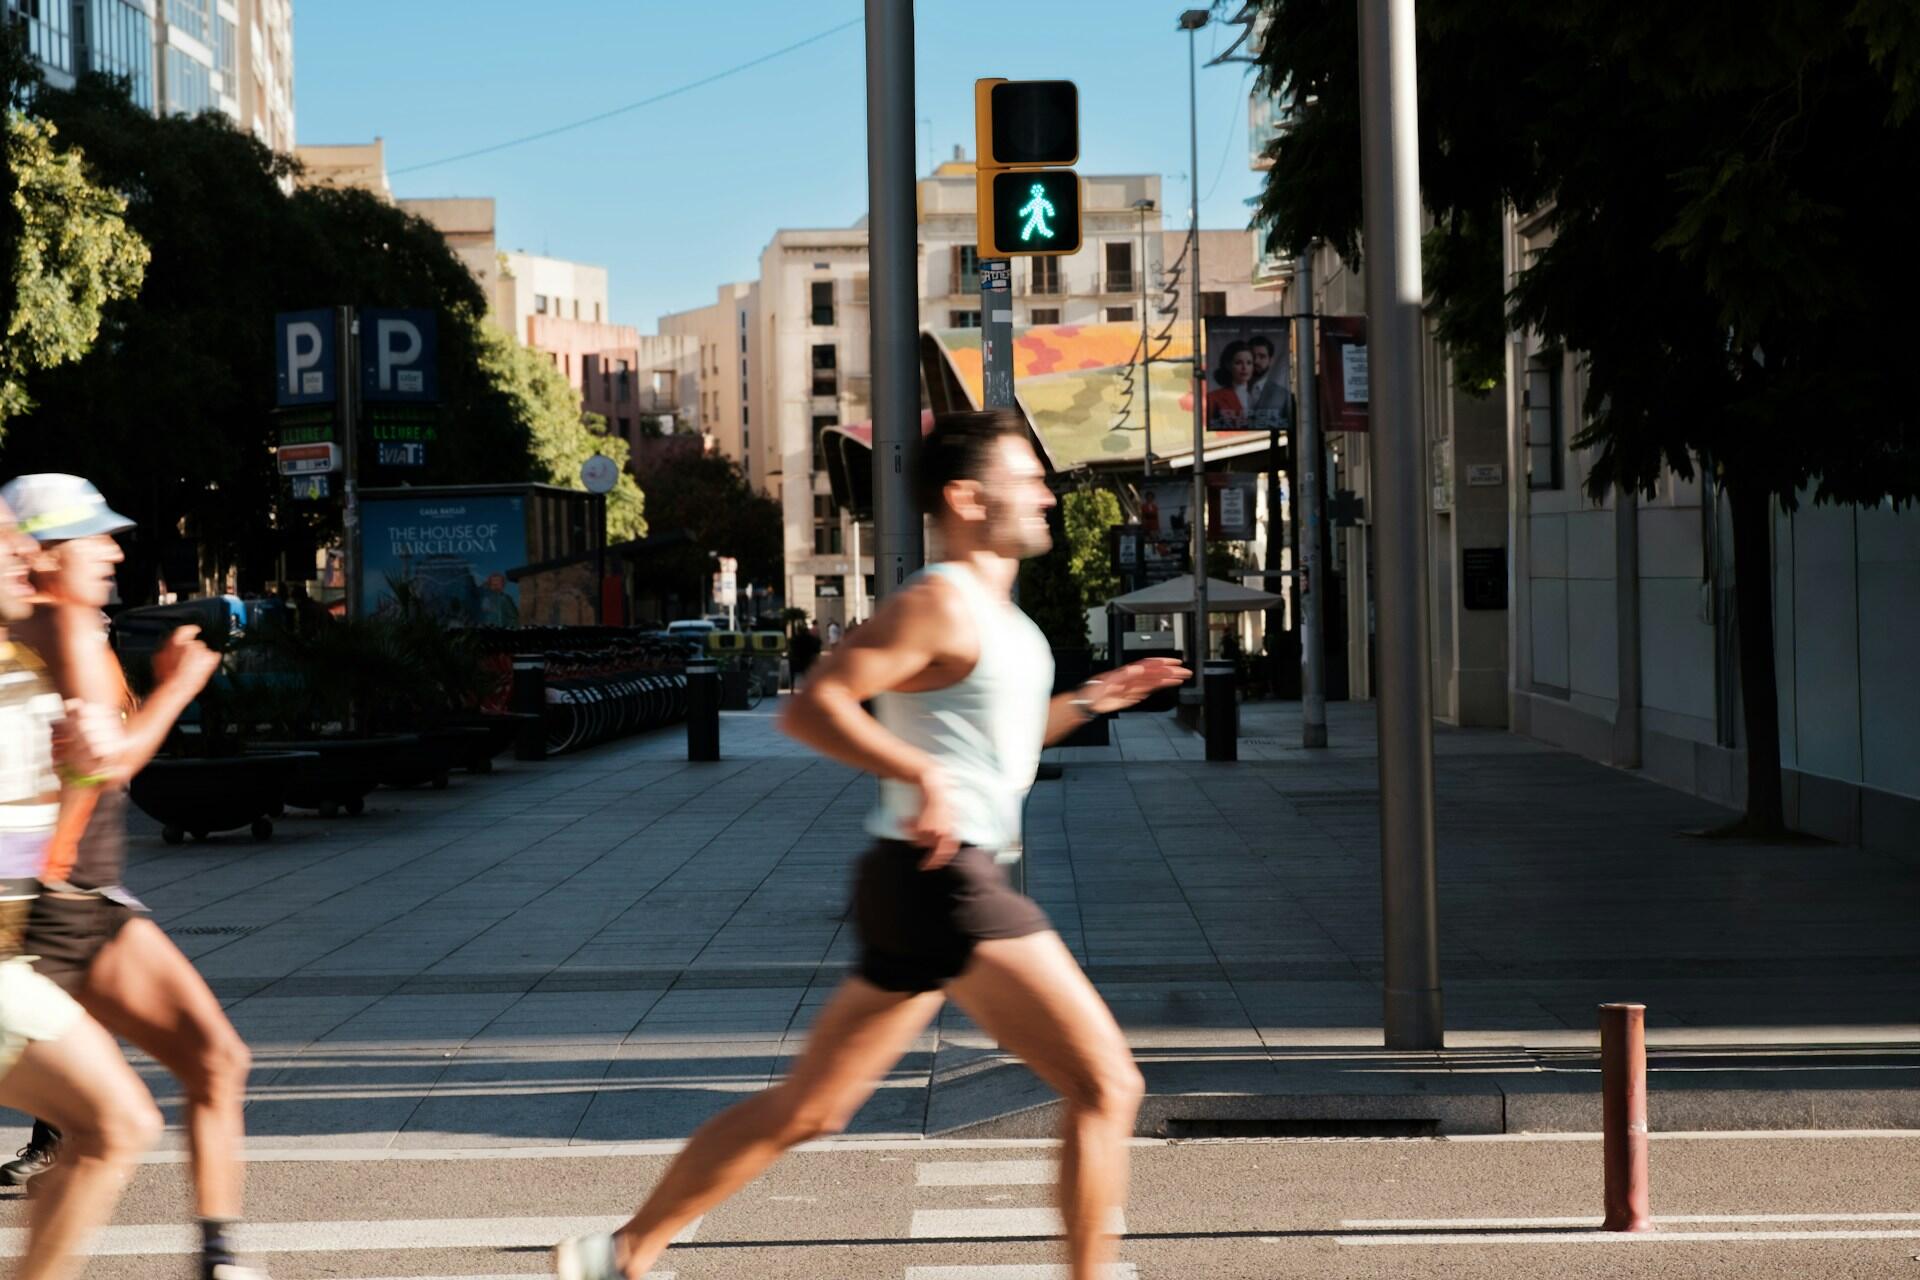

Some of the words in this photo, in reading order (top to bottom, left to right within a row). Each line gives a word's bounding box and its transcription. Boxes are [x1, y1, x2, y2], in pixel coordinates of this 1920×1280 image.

[286, 321, 323, 395] P
[376, 318, 423, 391] P
[387, 526, 416, 541] THE
[420, 524, 473, 540] HOUSE
[476, 524, 499, 538] OF
[391, 538, 498, 556] BARCELONA
